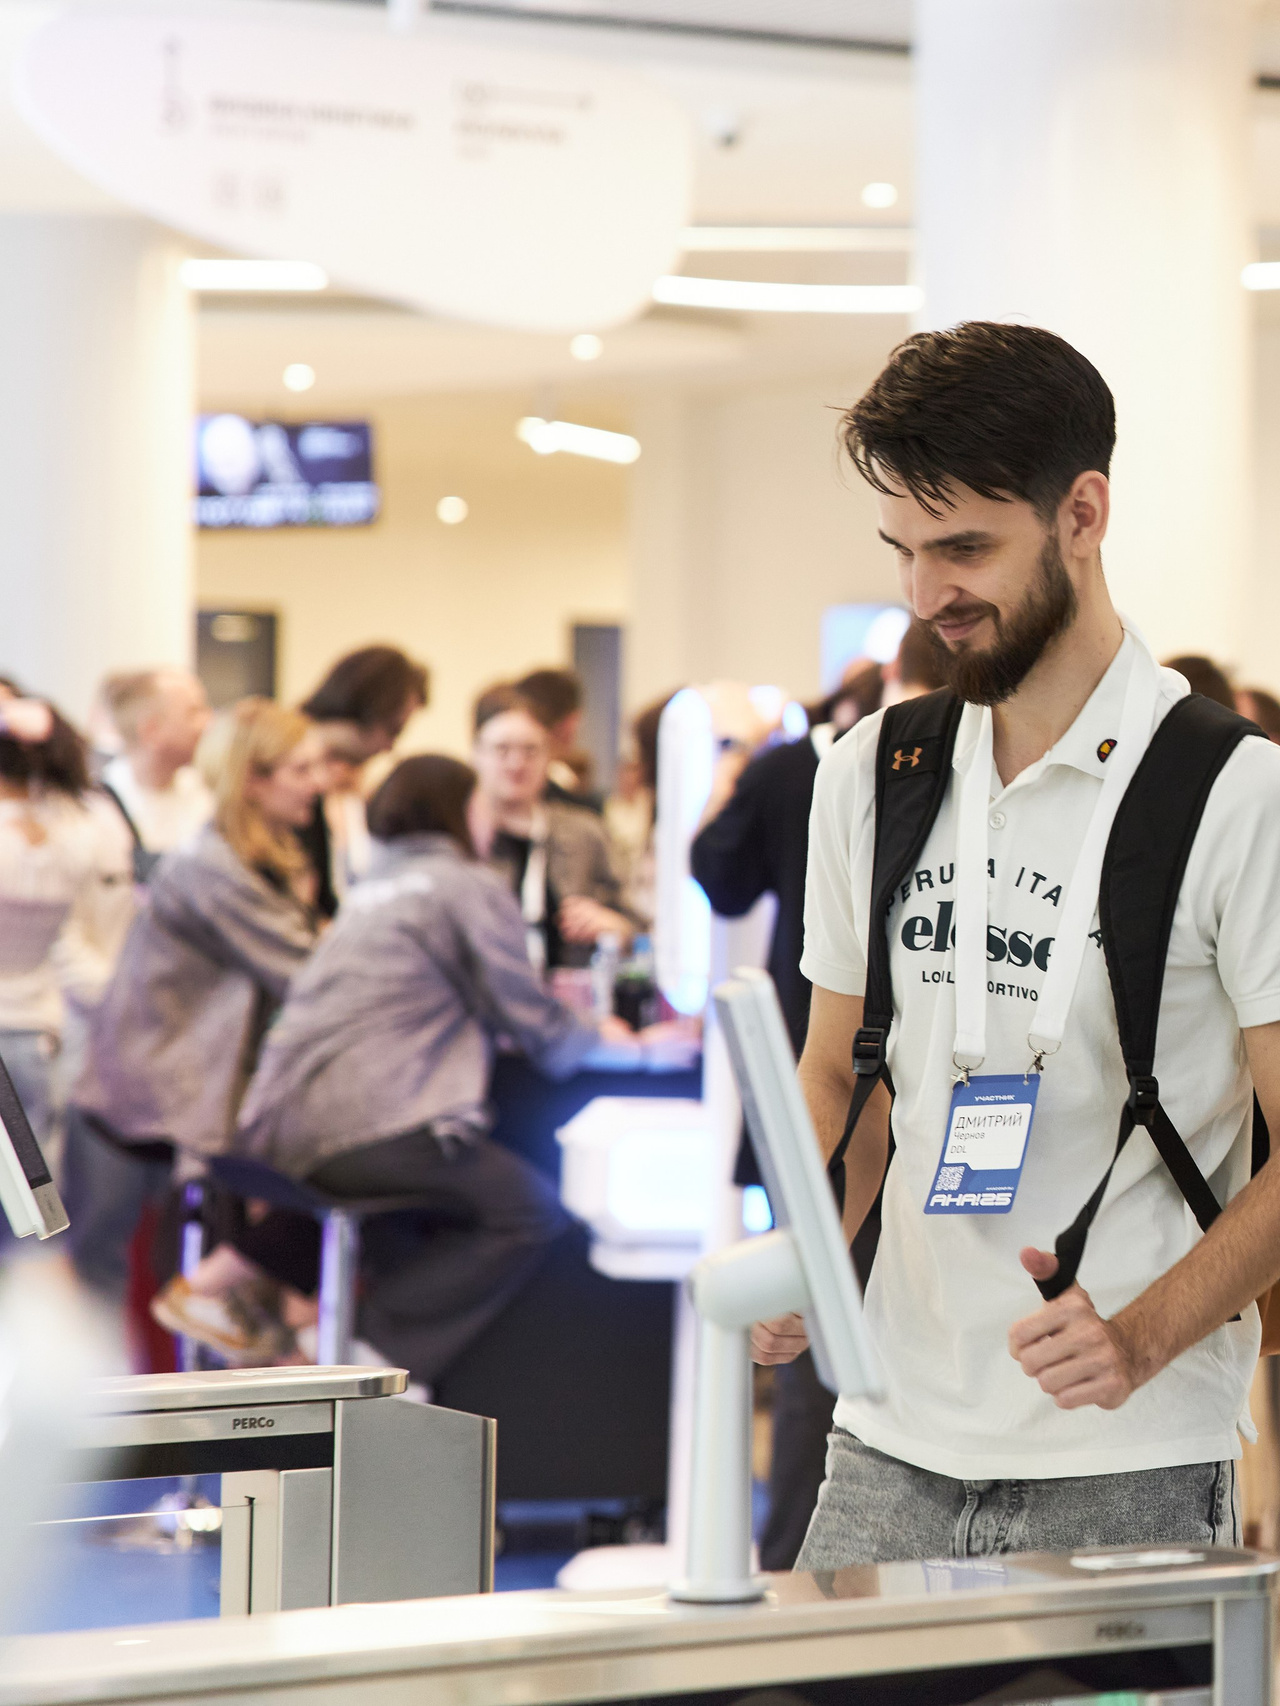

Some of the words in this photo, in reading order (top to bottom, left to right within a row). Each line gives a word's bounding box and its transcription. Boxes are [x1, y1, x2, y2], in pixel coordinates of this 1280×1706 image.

[885, 858, 996, 917] PERUA
[1015, 866, 1104, 949] ITAA
[901, 900, 1056, 973] elsse
[987, 980, 1039, 1002] ORTIVO
[974, 1094, 1016, 1102] УЧАСТНИК
[954, 1112, 1023, 1130] ДМИТРИЙ
[954, 1131, 986, 1141] Чернов
[950, 1144, 967, 1154] DDL
[232, 1416, 275, 1430] PERCo
